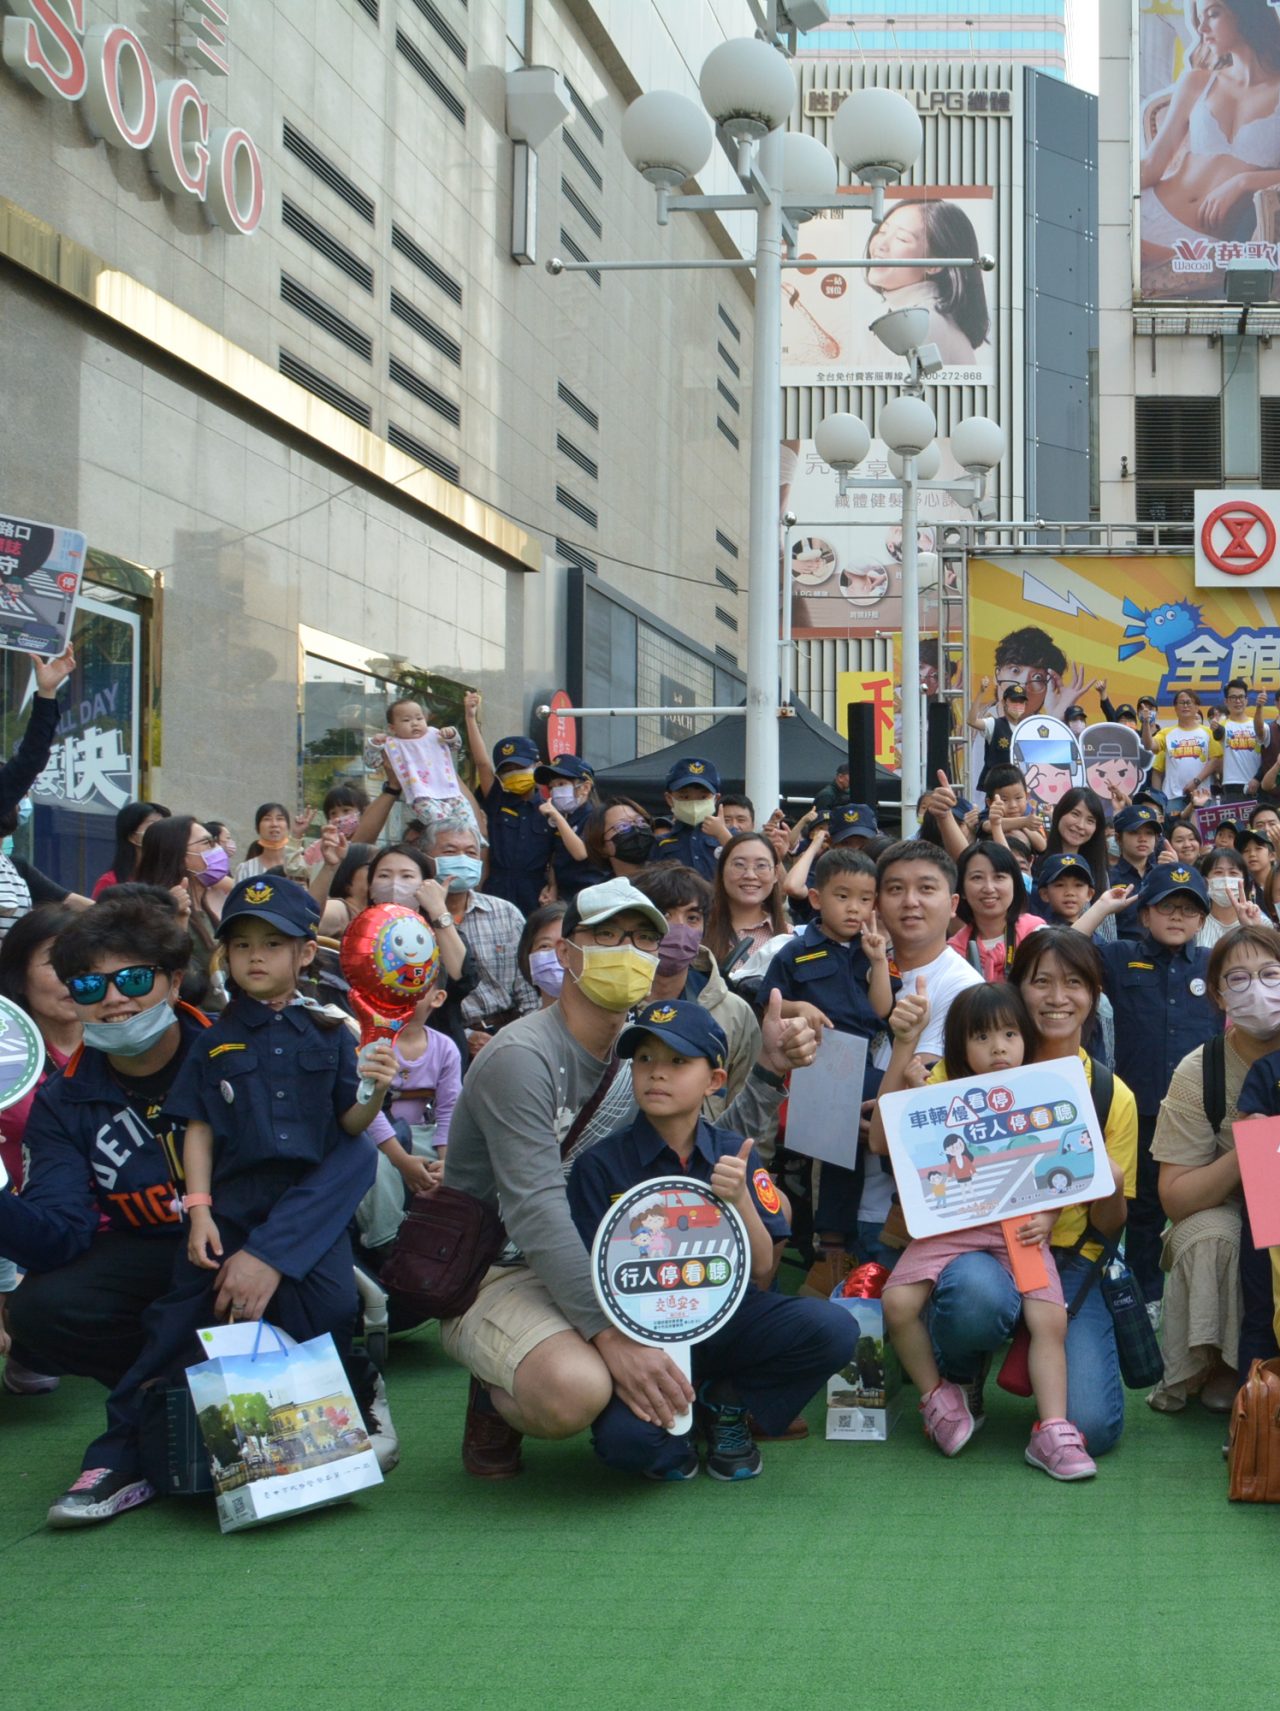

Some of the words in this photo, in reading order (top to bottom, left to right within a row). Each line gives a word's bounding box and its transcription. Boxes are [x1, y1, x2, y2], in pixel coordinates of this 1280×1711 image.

[22, 0, 265, 236] SOGO
[1173, 261, 1212, 271] Wacoal
[920, 372, 982, 381] 00-272-868
[80, 682, 119, 725] DAY
[908, 1092, 1010, 1129] 車輛慢看停
[969, 1103, 1076, 1142] 行人停看聽
[620, 1261, 728, 1289] 行人停看聽
[655, 1295, 700, 1312] 交通安全
